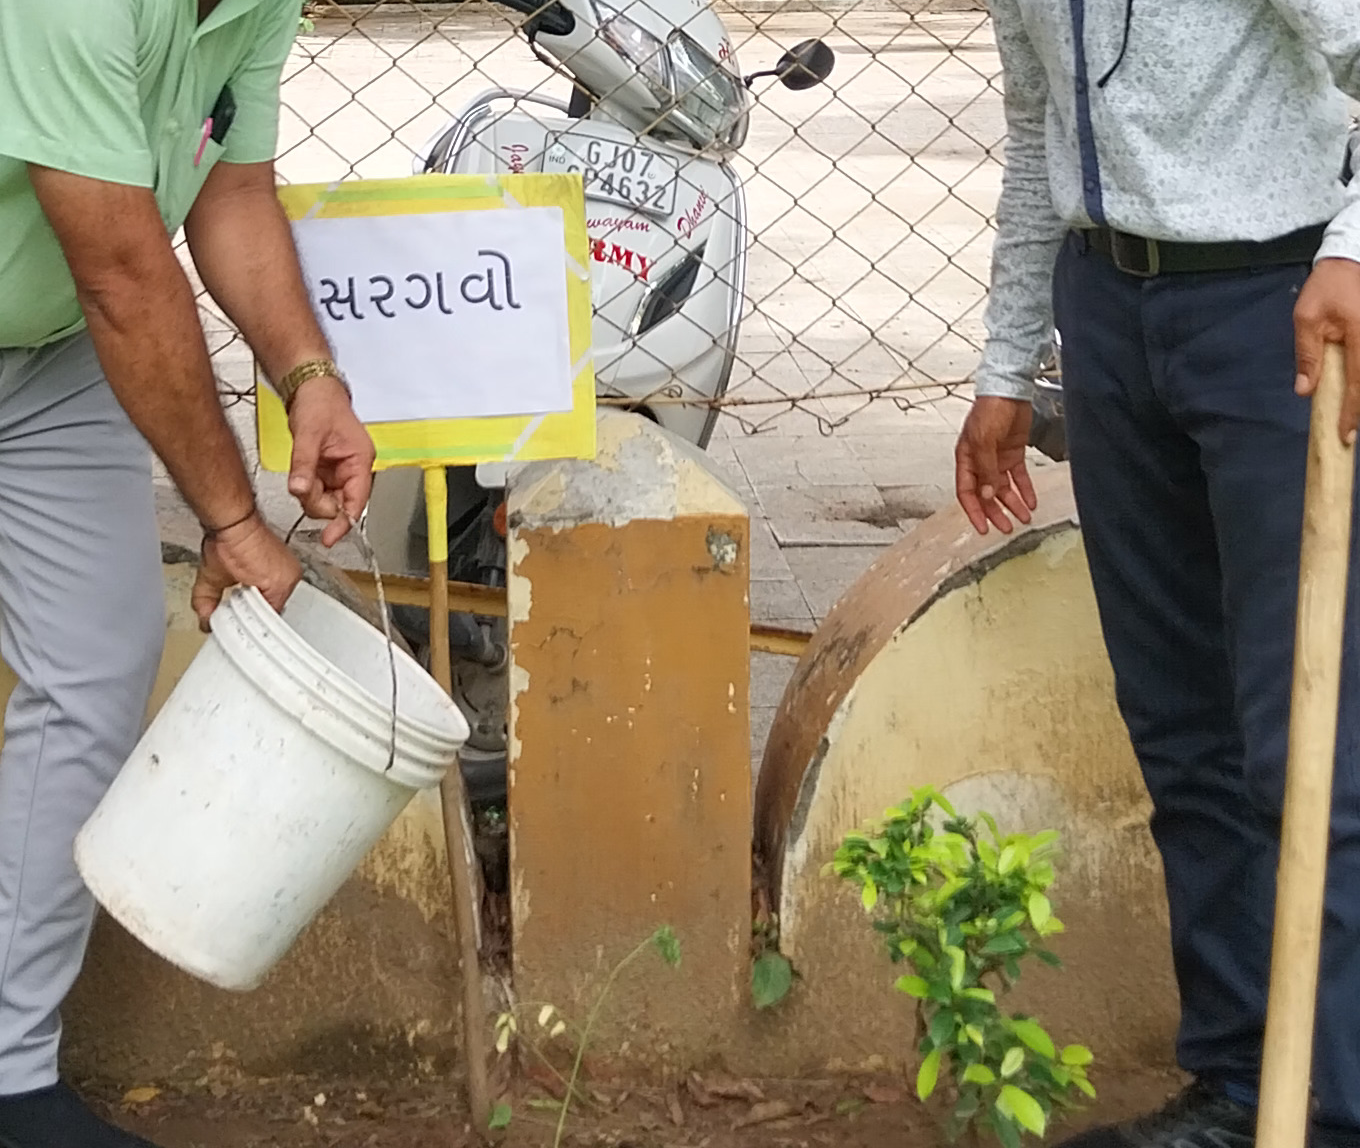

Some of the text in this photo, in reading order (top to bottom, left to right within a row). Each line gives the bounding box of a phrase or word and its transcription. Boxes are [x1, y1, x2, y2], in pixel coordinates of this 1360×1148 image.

[548, 154, 566, 165] IND
[587, 140, 654, 177] GJ07
[586, 217, 650, 232] wayam
[589, 236, 657, 282] RMY
[320, 249, 522, 321] સરગવો
